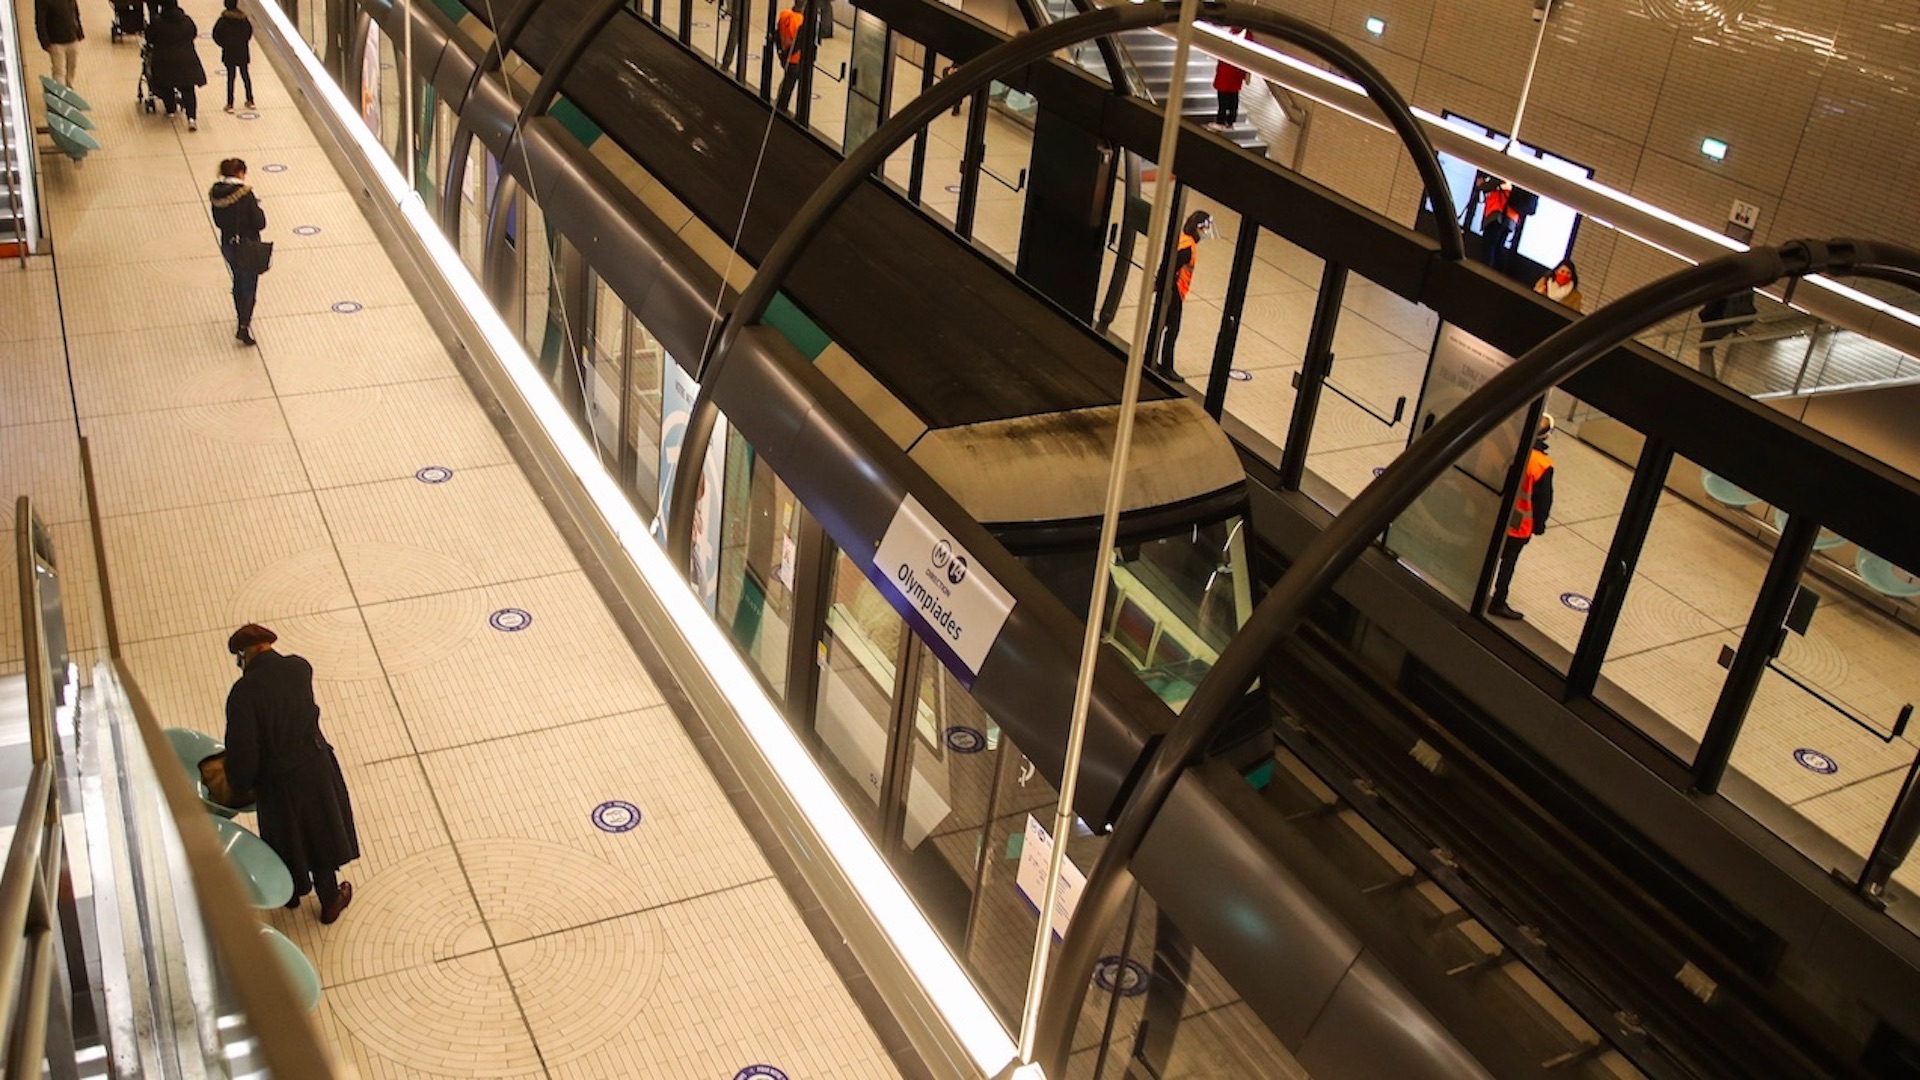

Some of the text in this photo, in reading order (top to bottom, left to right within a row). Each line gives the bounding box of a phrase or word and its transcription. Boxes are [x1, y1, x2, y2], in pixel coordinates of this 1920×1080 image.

[935, 547, 963, 581] M 14
[926, 568, 951, 597] DIRECTION
[898, 564, 962, 640] Olympiades
